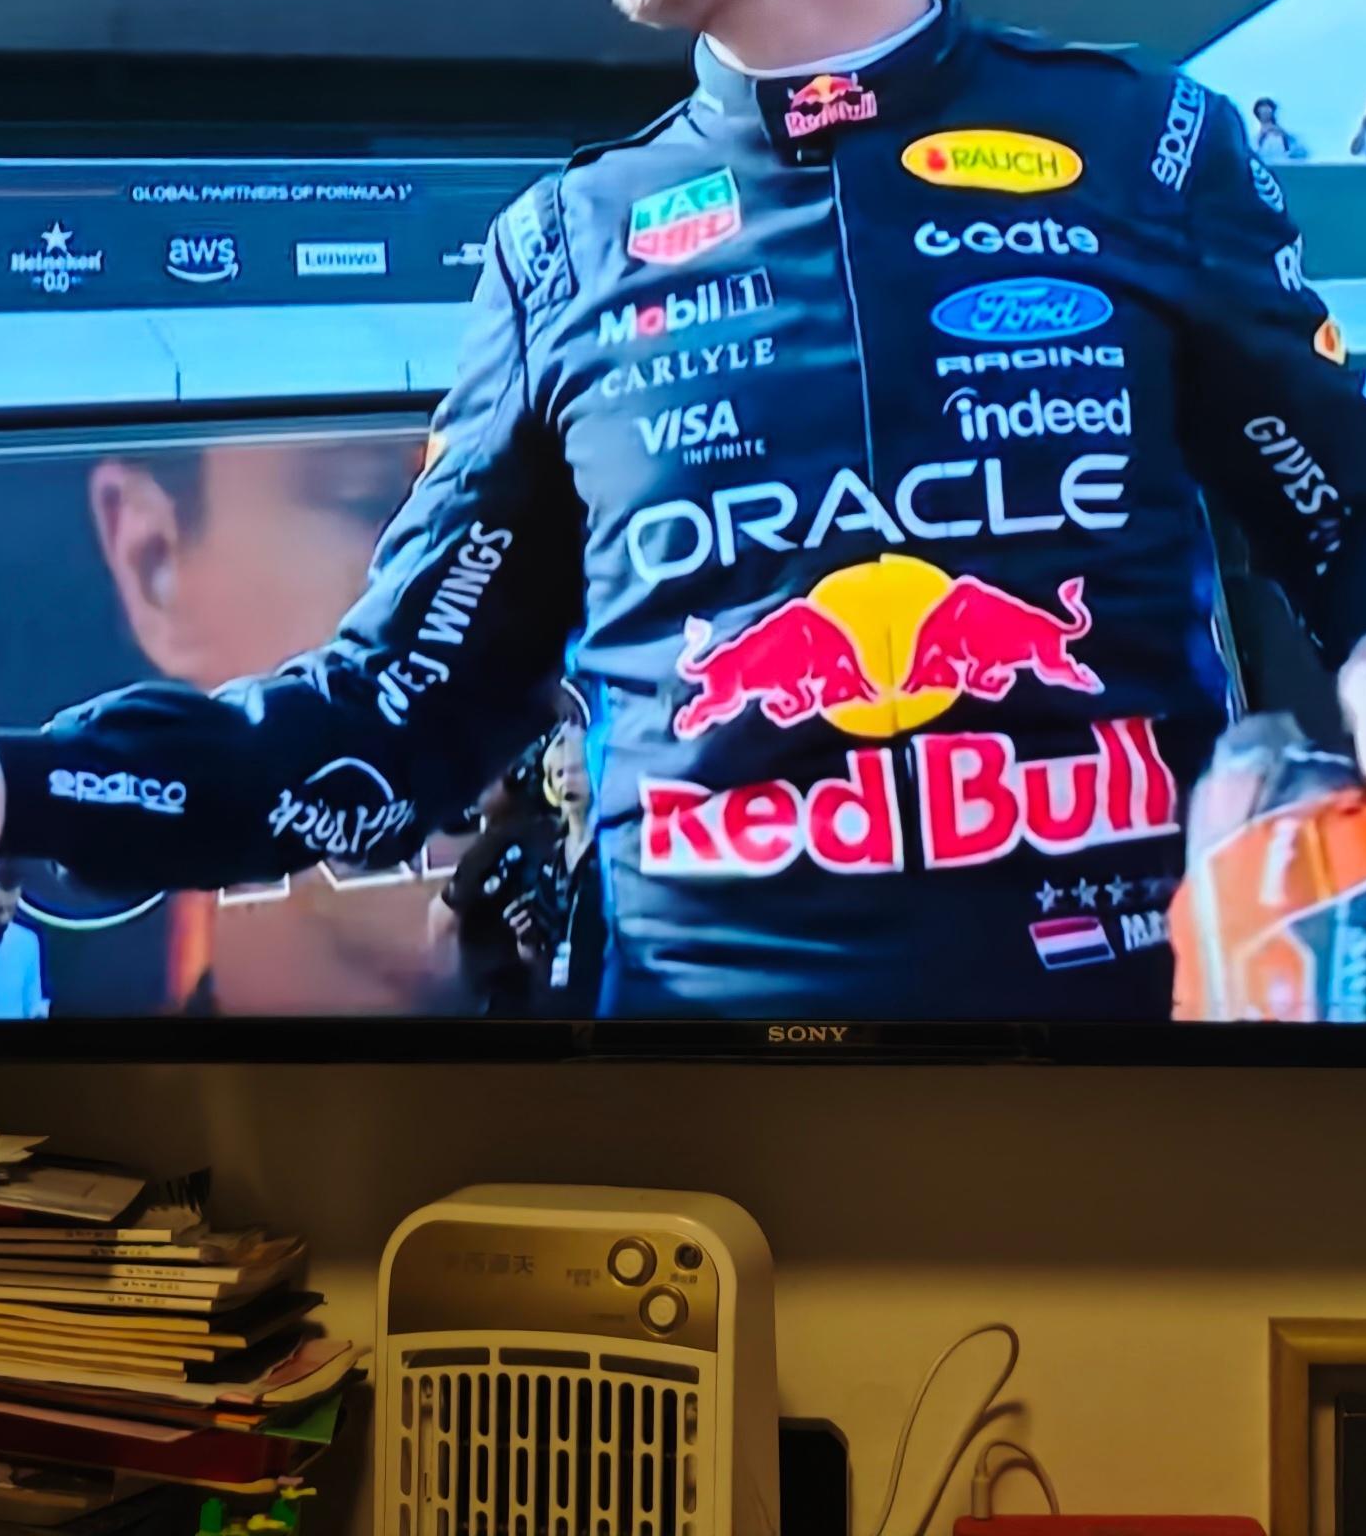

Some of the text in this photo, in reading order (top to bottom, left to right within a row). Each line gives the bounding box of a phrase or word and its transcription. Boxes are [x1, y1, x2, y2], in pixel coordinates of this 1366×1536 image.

[951, 146, 1059, 179] RAUCH
[132, 185, 198, 201] GLOBAL
[202, 185, 288, 201] PARTNERS
[292, 185, 313, 200] OF
[317, 184, 395, 200] FORMULA
[169, 236, 237, 265] aws
[304, 247, 378, 267] Lenovo
[596, 286, 721, 345] Mobil
[971, 286, 1079, 335] Ford
[600, 338, 776, 398] CARLYLE
[936, 346, 1125, 378] RACING
[637, 400, 740, 455] VISA
[949, 388, 1132, 442] indeed
[683, 439, 766, 466] INFINITE
[1244, 415, 1339, 515] GIVES
[624, 452, 1130, 583] ORACLE
[417, 520, 513, 646] WINGS
[639, 716, 1180, 877] Red Bull
[768, 1026, 848, 1043] SONY
